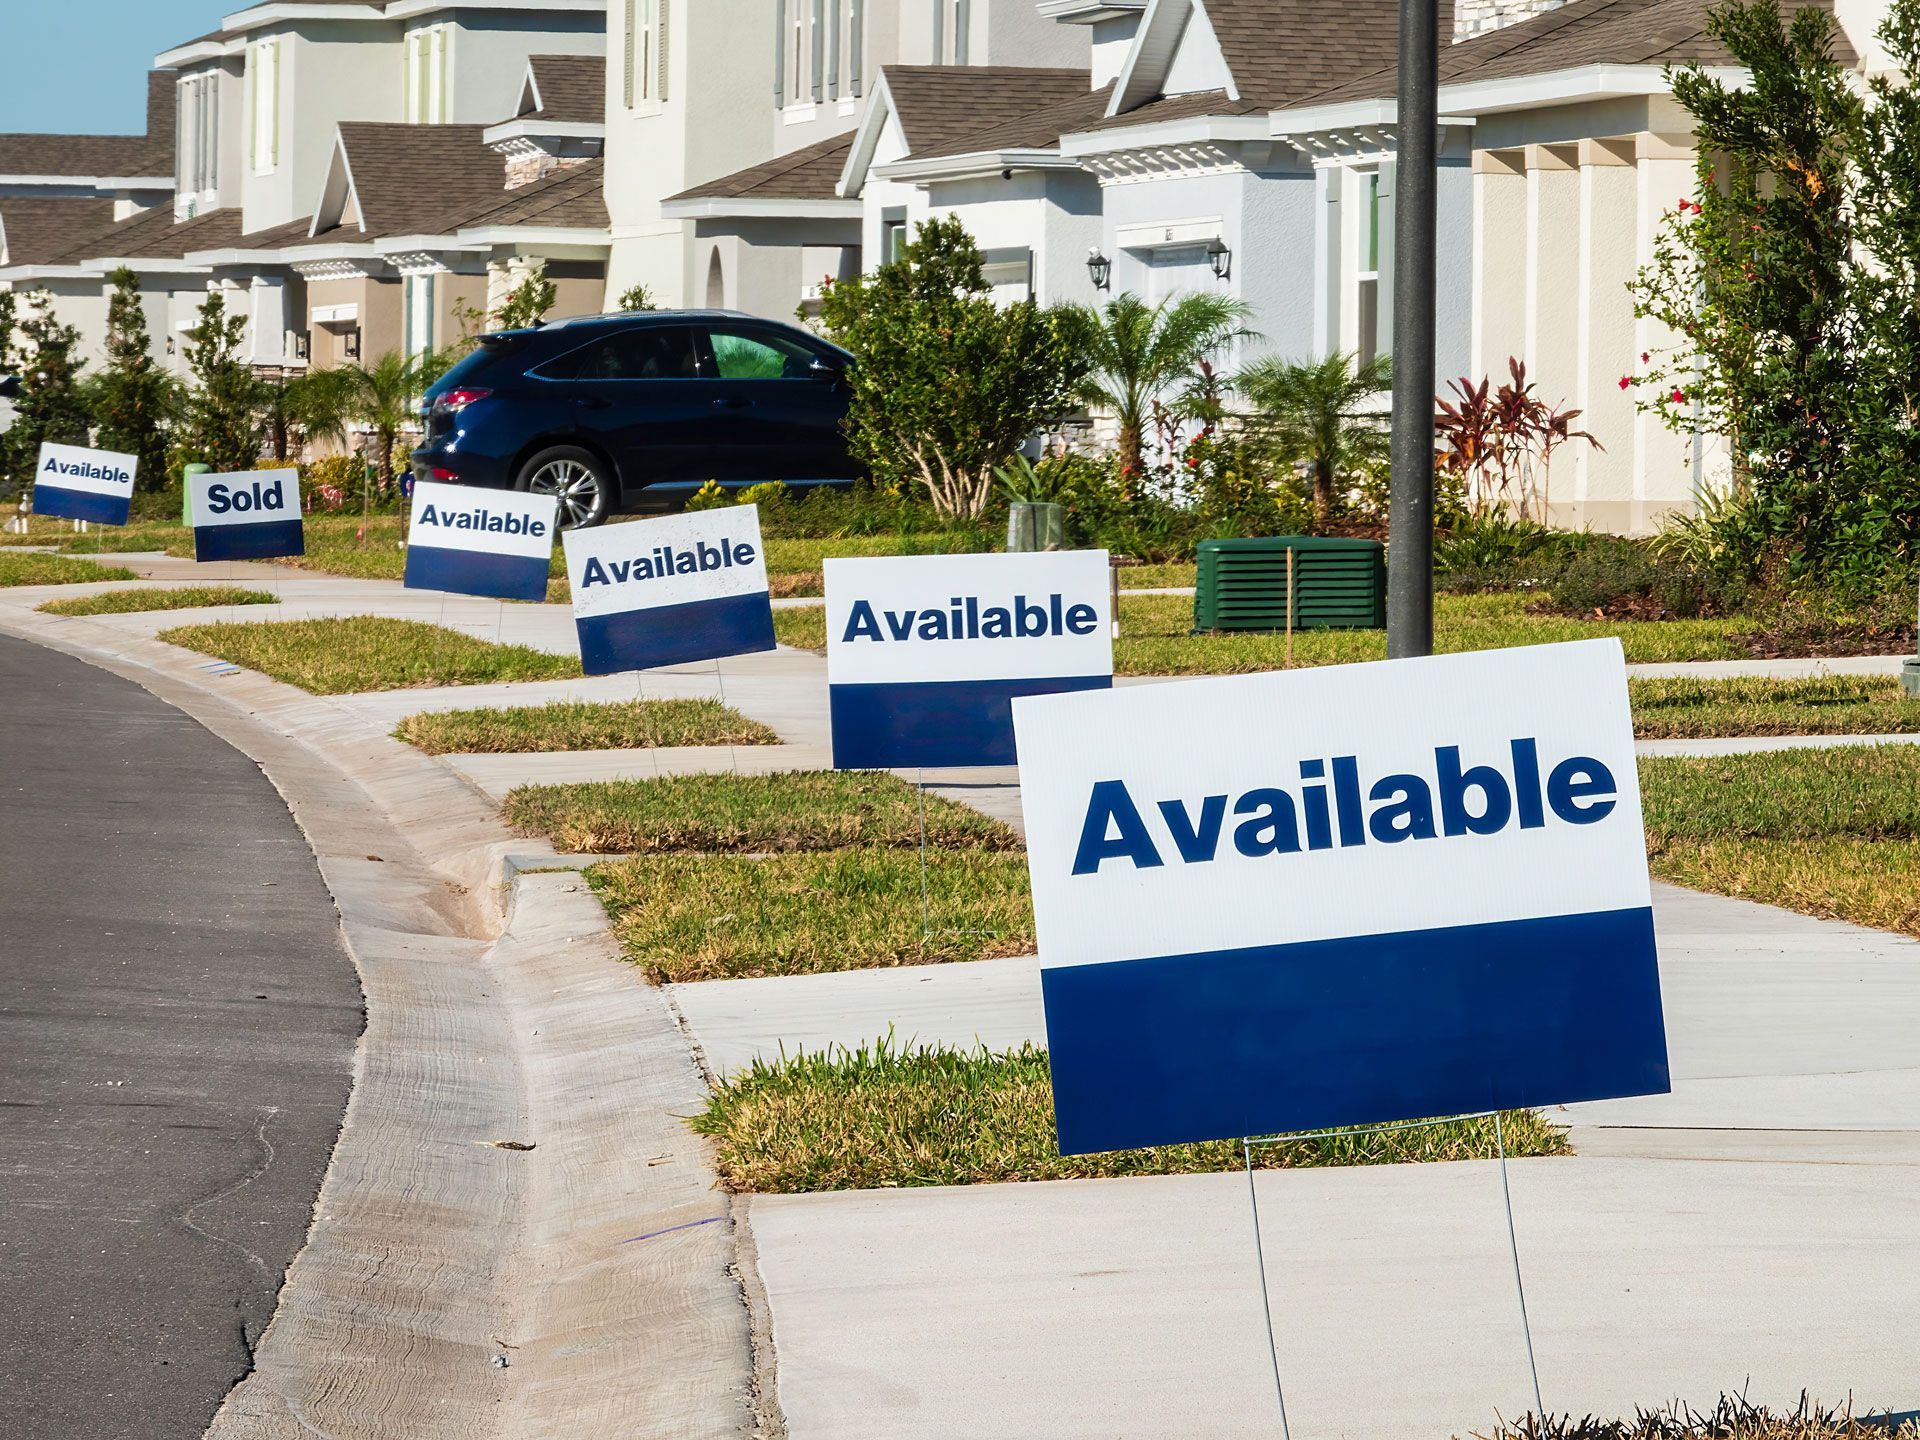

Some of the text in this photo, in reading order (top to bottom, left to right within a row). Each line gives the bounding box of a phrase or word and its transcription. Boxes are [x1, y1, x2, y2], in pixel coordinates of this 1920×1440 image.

[43, 457, 130, 484] Available
[207, 480, 284, 514] Sold
[418, 503, 546, 538] Available
[581, 537, 756, 589] Available
[841, 593, 1098, 643] Available
[1072, 737, 1618, 876] Available
